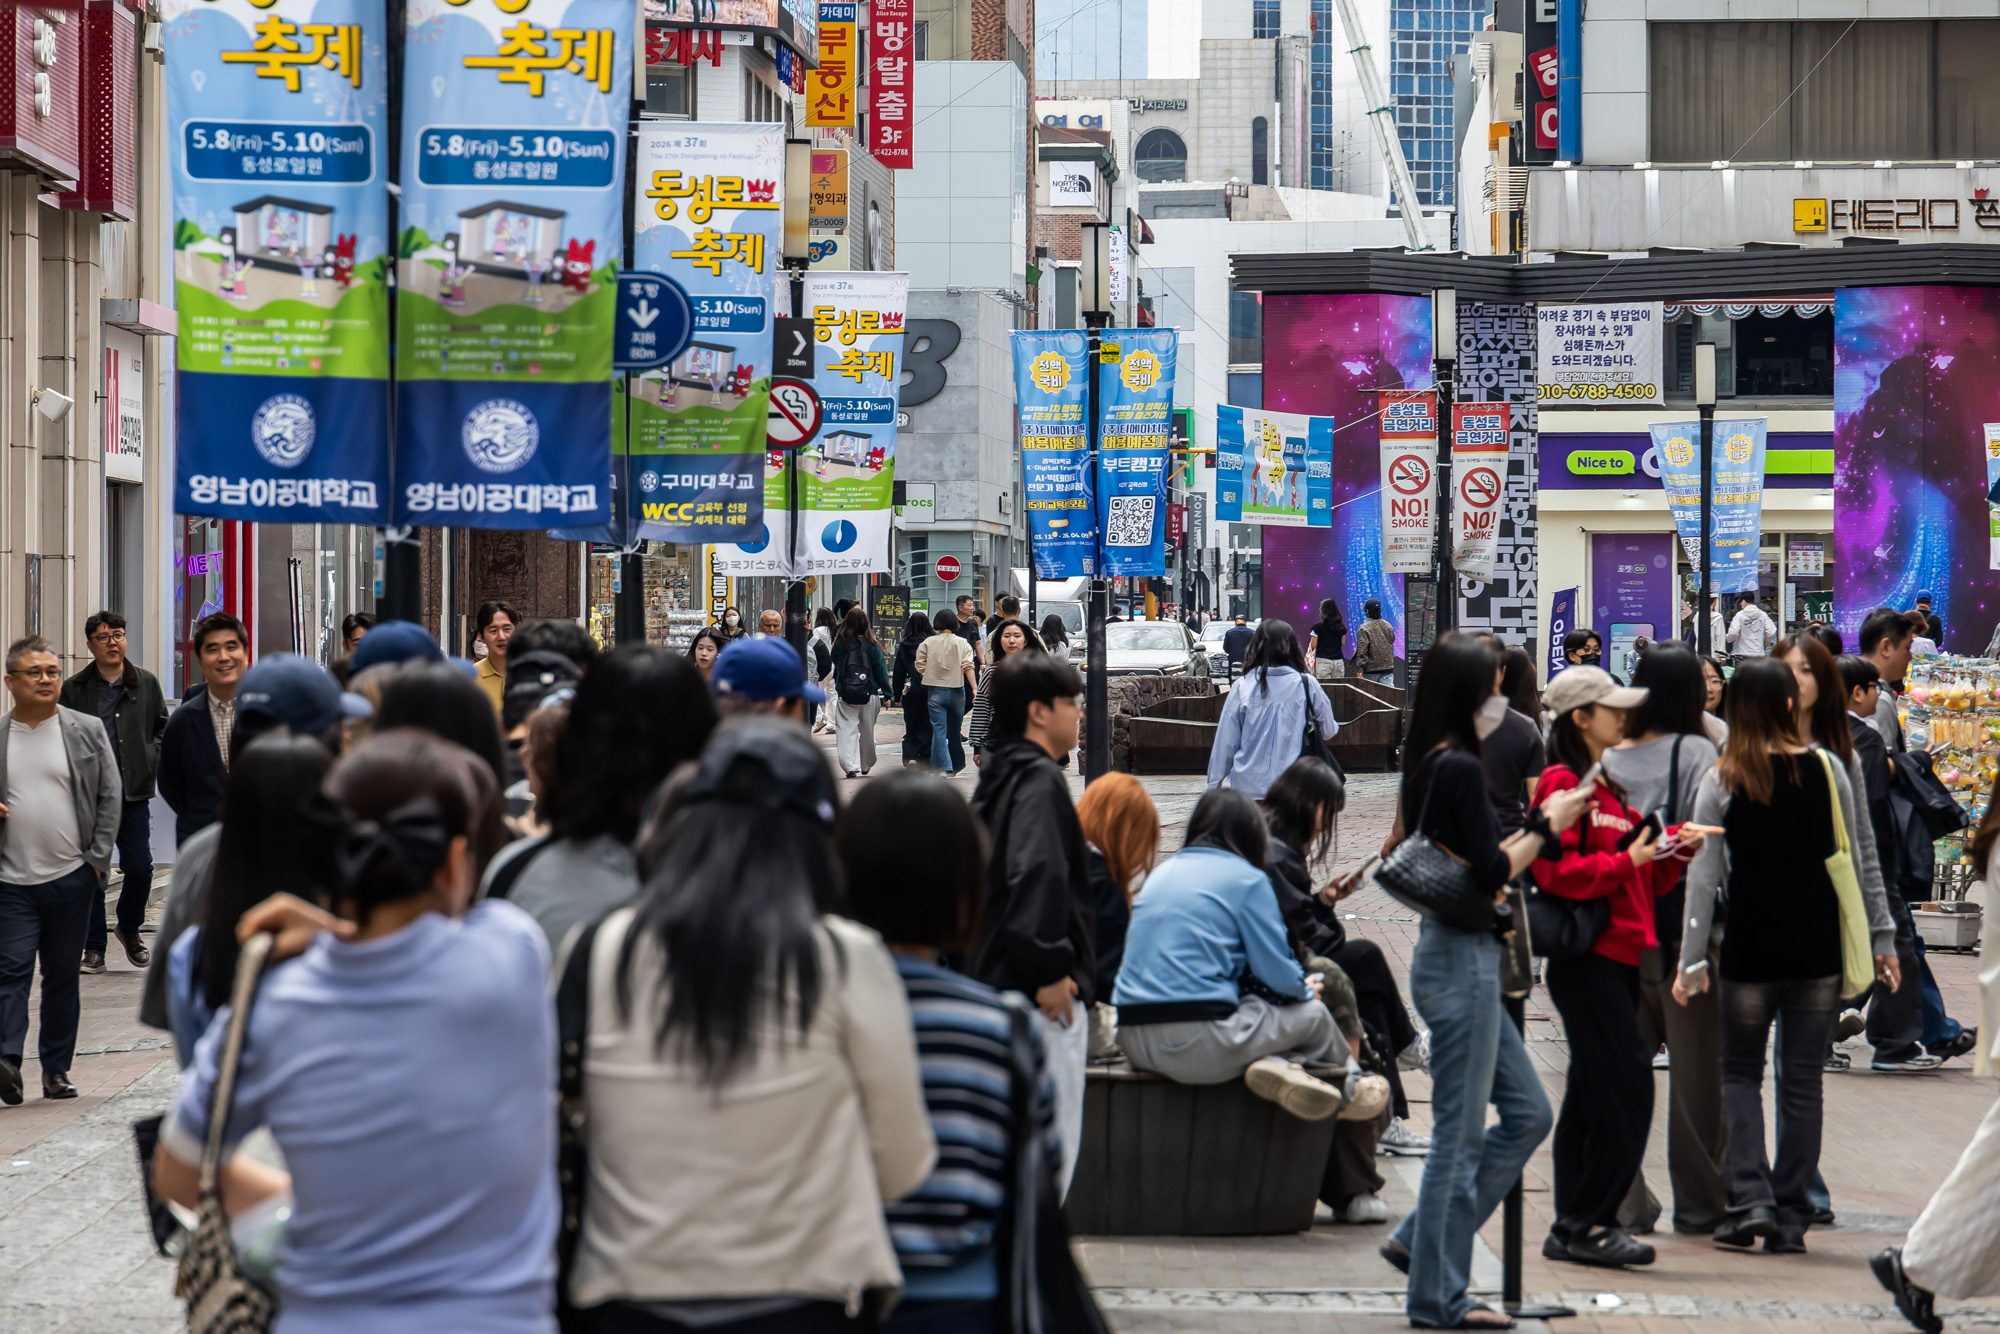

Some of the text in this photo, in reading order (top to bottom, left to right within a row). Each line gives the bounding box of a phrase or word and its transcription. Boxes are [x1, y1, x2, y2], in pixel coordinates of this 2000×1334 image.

[819, 6, 855, 19] 카데미
[738, 34, 748, 42] 3F
[221, 15, 361, 92] 축제
[463, 20, 614, 97] 축제
[815, 27, 849, 121] 부동산
[875, 22, 908, 121] 방탈출
[1147, 100, 1187, 111] 치과의원
[192, 128, 364, 156] 5.8(Fri)~5.10(Sun)
[880, 126, 902, 144] 3F
[427, 135, 610, 160] 5.8(Fri)~5.10(Sun)
[651, 140, 672, 149] 2026
[674, 139, 682, 148] 제
[728, 154, 754, 162] Festival
[881, 147, 908, 157] 422-8788
[241, 156, 323, 176] 동성로일원
[473, 161, 558, 180] 동성로일원
[817, 176, 831, 191] 수
[645, 170, 780, 224] 동성로
[809, 217, 844, 226] 25-0009
[671, 228, 765, 277] 축제
[824, 241, 835, 255] 2
[629, 283, 660, 299] 후방
[1539, 309, 1651, 322] 어려운 경기 속 부담없이
[813, 305, 905, 345] 동성로
[1554, 325, 1634, 338] 장사하실 수 있게
[1563, 340, 1626, 352] 심해돈까스가
[787, 359, 807, 367] 350m
[826, 348, 894, 384] 축제
[1038, 359, 1062, 373] 전액
[1128, 357, 1153, 372] 전액
[1551, 355, 1637, 367] 도와드리겠습니다.
[1039, 374, 1063, 388] 국비
[1128, 373, 1152, 386] 국비
[1556, 372, 1633, 382] 부담없이 전화주세요!
[1537, 383, 1657, 399] 010-6788-4500
[830, 412, 868, 421] 동성로일원
[1389, 402, 1428, 417] 동성로
[1383, 418, 1434, 432] 금연거리
[1462, 415, 1501, 430] 동성로
[1021, 435, 1087, 450] 채용예정자
[1101, 434, 1168, 450] 채용예정자
[1456, 430, 1507, 445] 금연거리
[1102, 457, 1163, 472] 부트캠프
[1577, 457, 1623, 468] Nice to
[661, 472, 754, 490] 구미대학교
[1027, 483, 1053, 491] 전문가
[189, 474, 379, 509] 영남이공대학교
[405, 481, 598, 514] 영남이공대학교
[696, 502, 747, 513] 교육부 선정
[1070, 499, 1087, 508] 모집
[1391, 499, 1428, 517] NO!
[642, 503, 694, 520] WCC
[694, 515, 723, 526] 세계적
[726, 515, 747, 526] 대학
[1391, 519, 1429, 528] SMOKE
[1463, 511, 1496, 530] NO!
[1463, 530, 1492, 541] SMOKE
[875, 604, 905, 616] 방탈출
